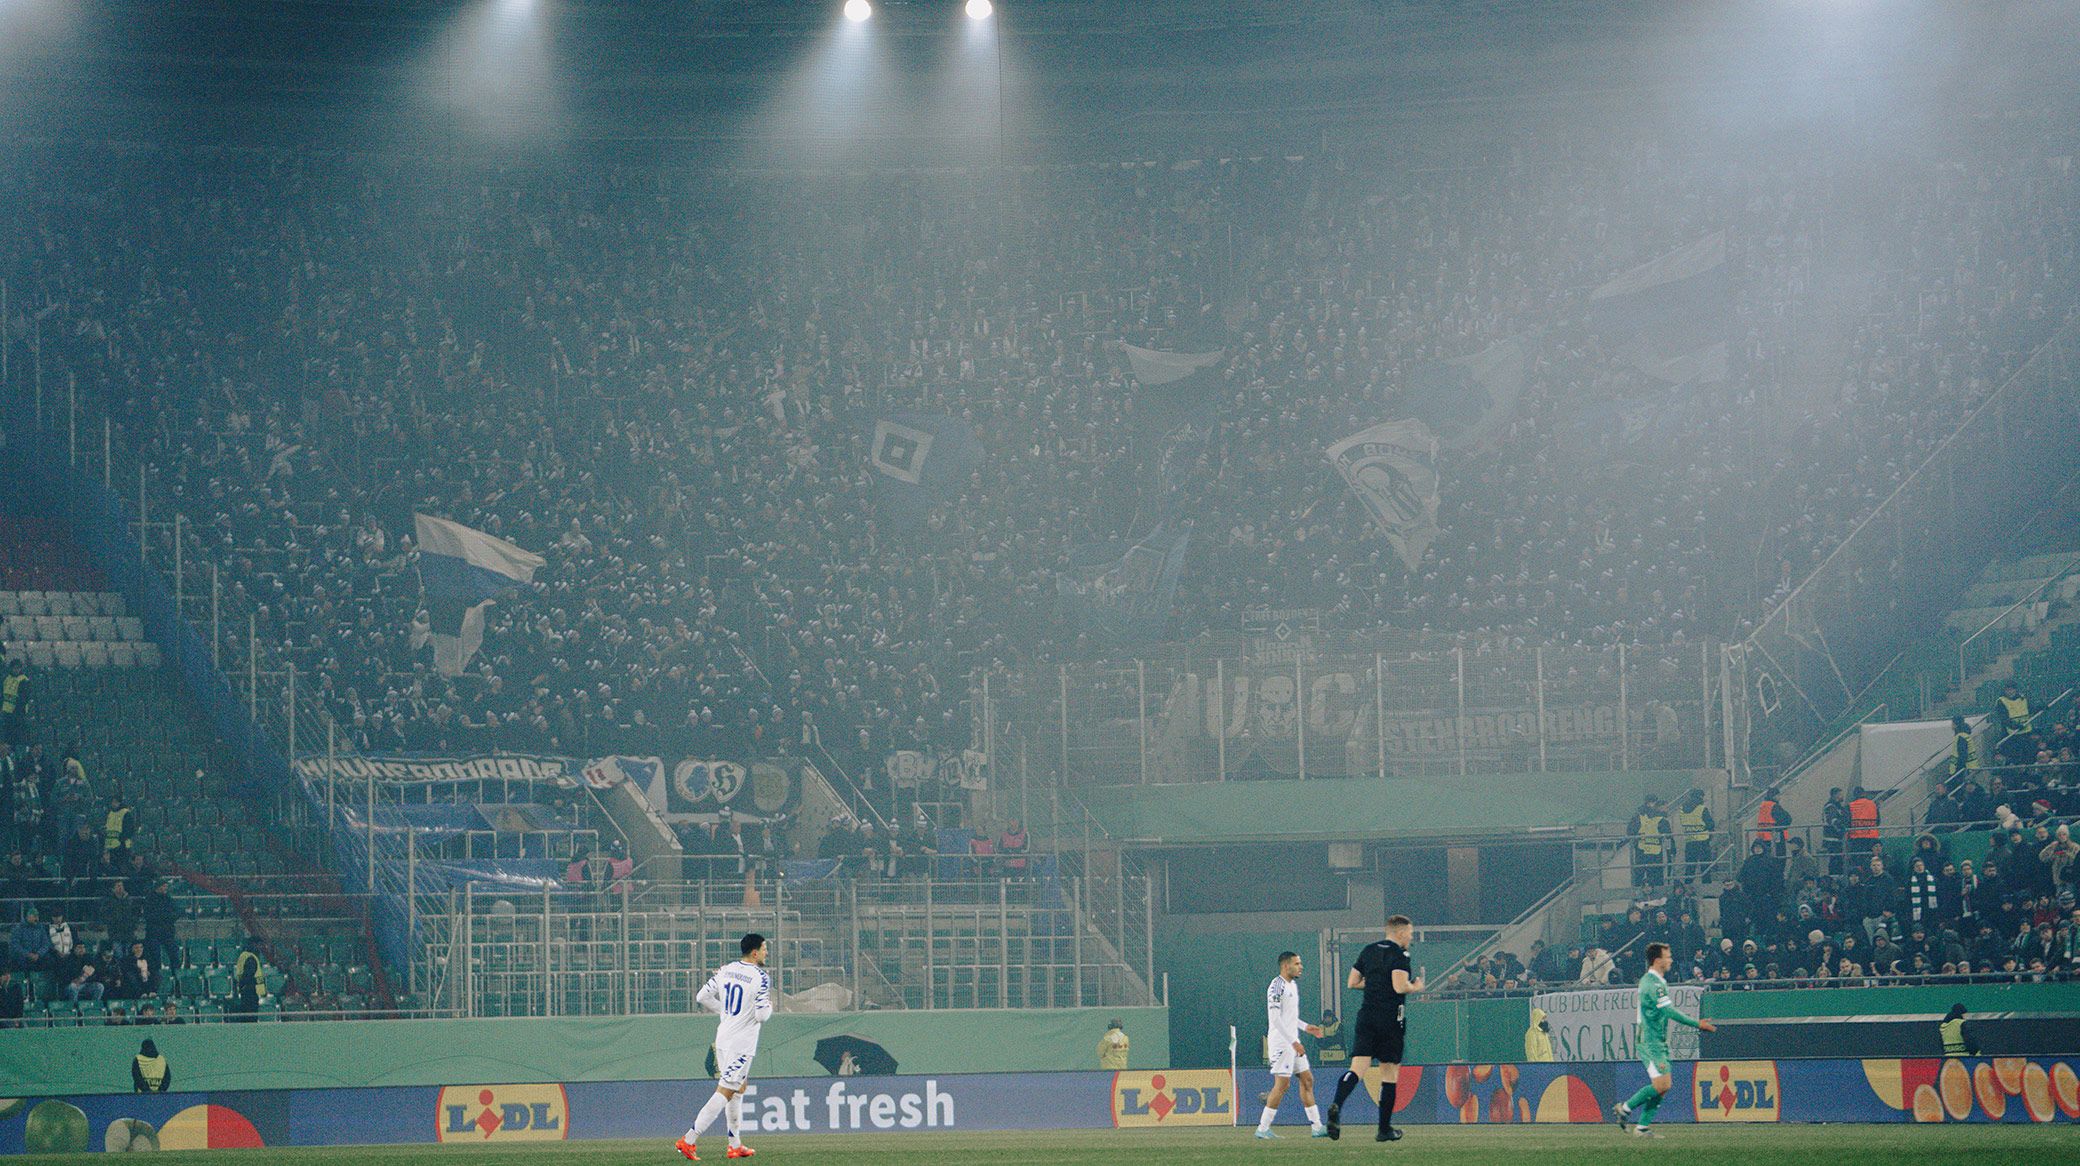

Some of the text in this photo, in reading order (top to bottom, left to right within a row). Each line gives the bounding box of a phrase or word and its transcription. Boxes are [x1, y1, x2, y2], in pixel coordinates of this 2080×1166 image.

[724, 982, 744, 1016] 10
[1531, 994, 1567, 1013] KLUB
[1571, 993, 1600, 1012] DER
[1674, 989, 1700, 1007] DES
[1560, 1024, 1596, 1062] S.C.
[739, 1079, 956, 1132] Eat fresh
